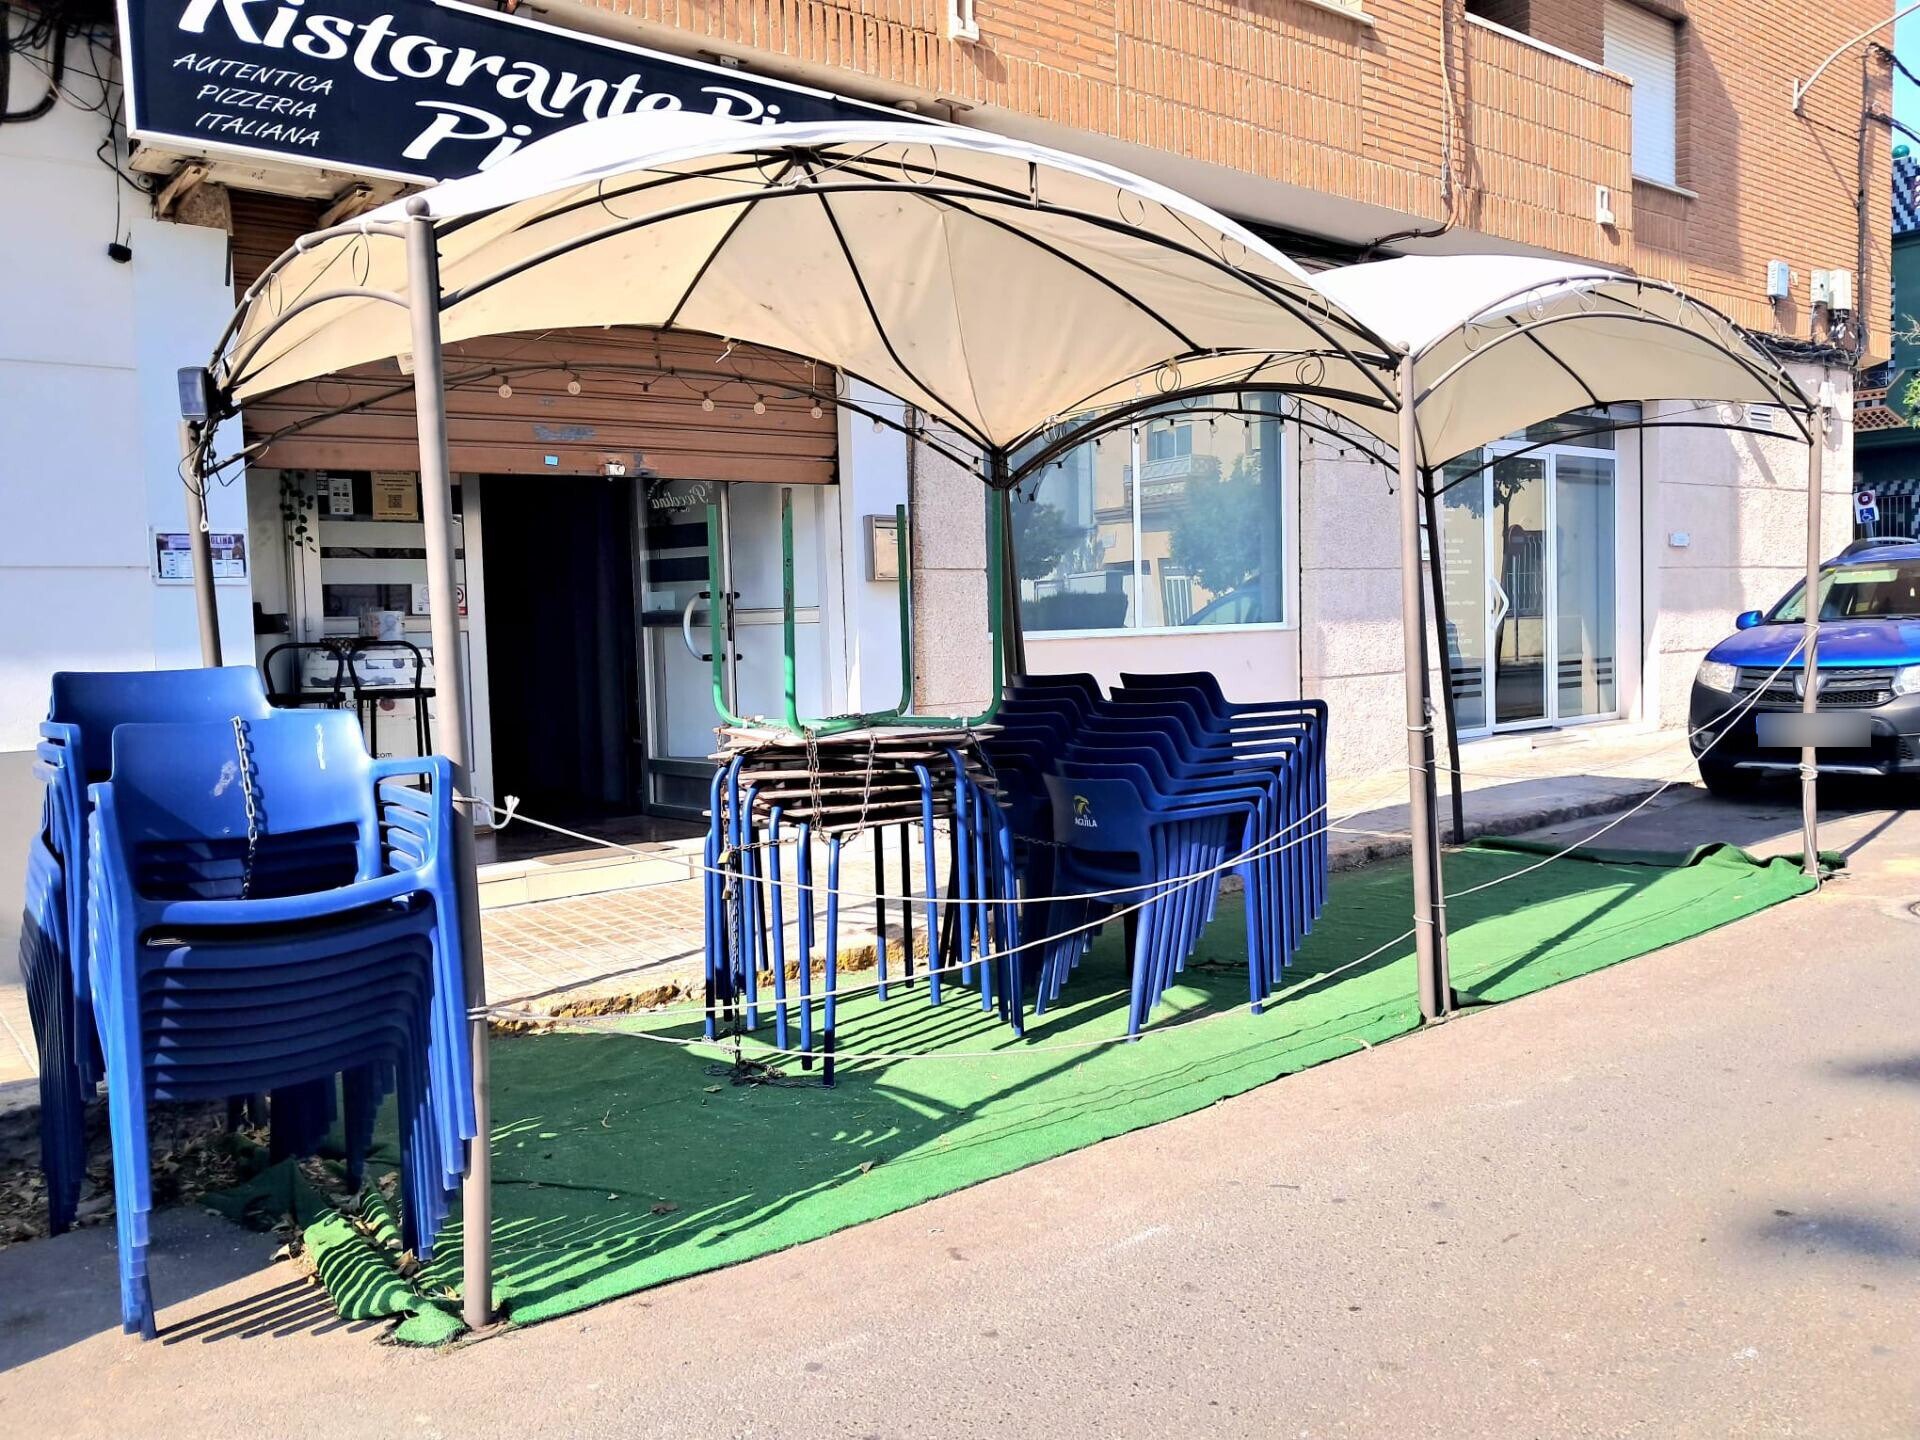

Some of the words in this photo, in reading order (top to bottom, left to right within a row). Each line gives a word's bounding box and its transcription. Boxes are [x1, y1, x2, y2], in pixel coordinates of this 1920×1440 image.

[173, 53, 334, 96] AUTENTICA
[196, 84, 317, 120] PIZZERIA
[195, 112, 320, 147] ITALIANA
